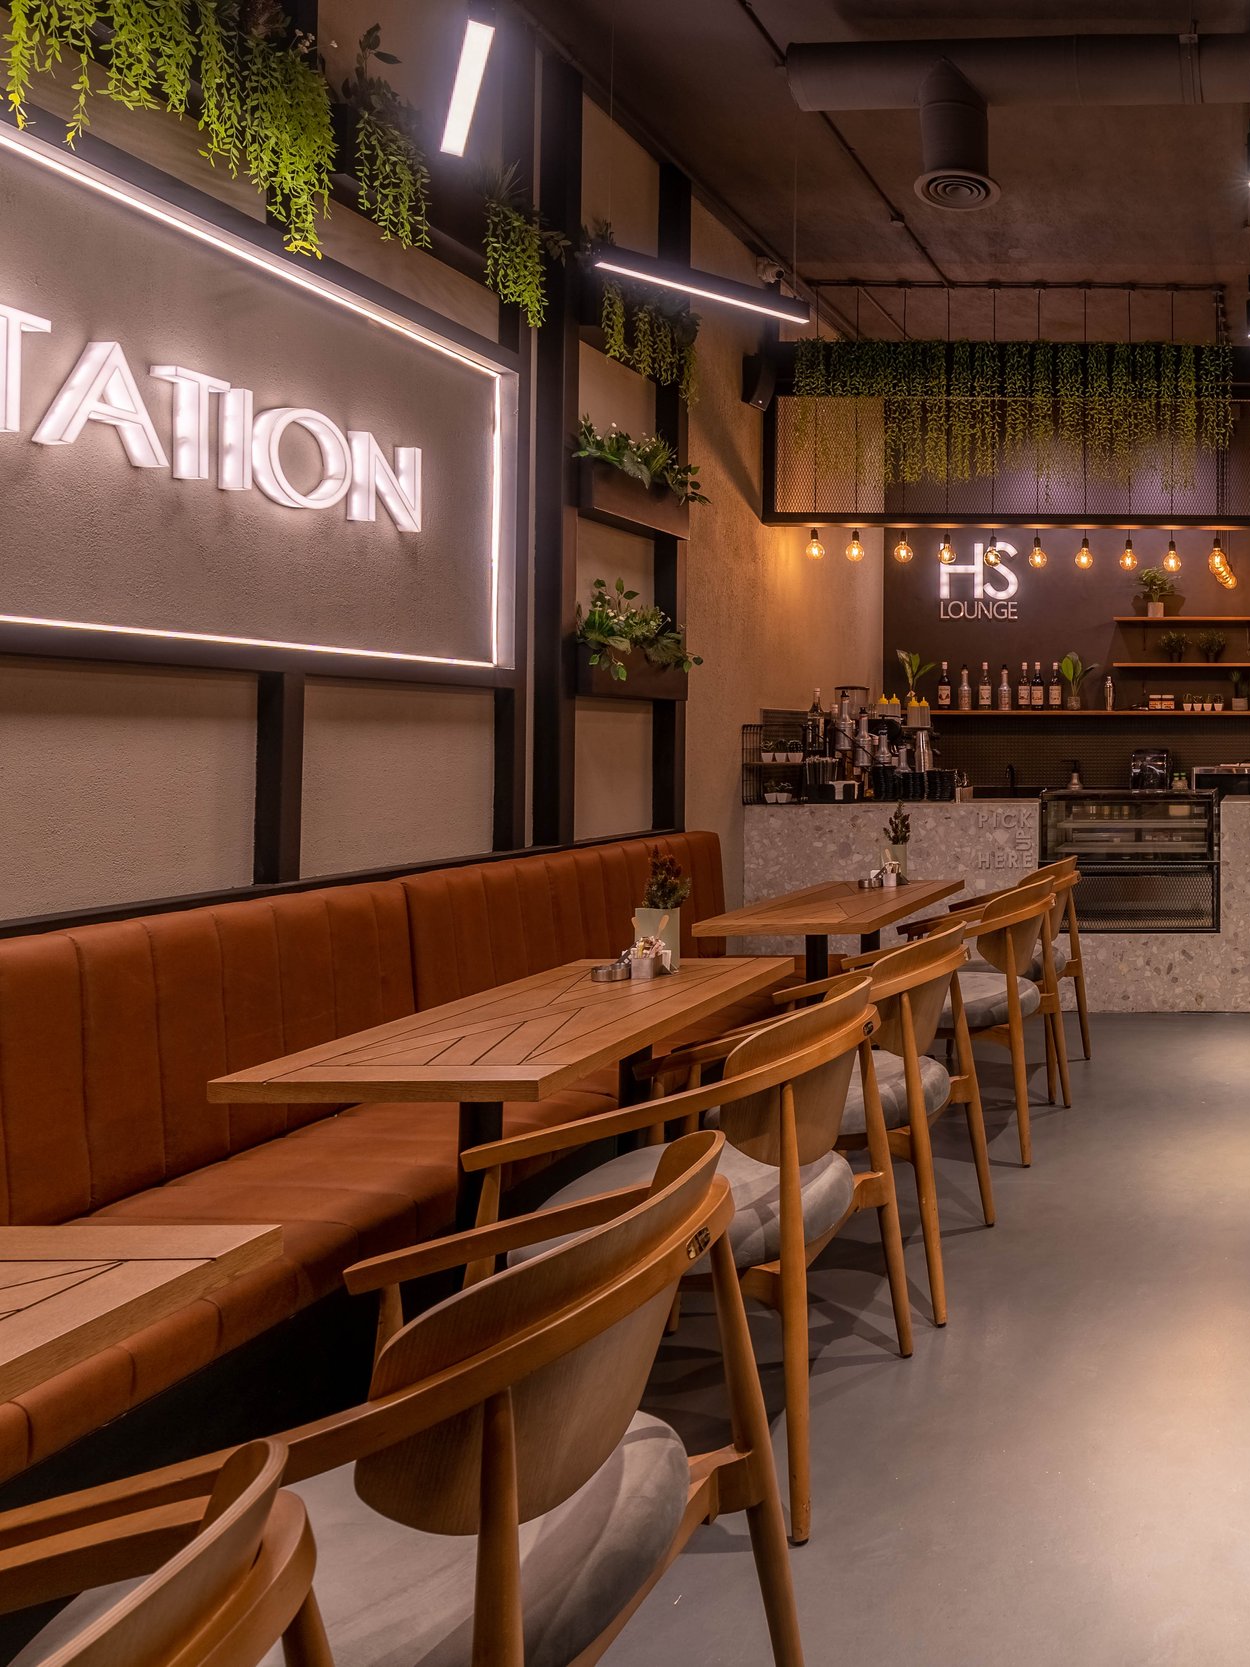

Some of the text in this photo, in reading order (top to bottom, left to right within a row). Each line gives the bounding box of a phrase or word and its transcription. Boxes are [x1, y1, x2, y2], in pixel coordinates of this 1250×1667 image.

[0, 303, 422, 532] TATION
[940, 541, 1019, 600] HS
[940, 600, 1018, 620] LOUNGE
[977, 810, 1033, 829] PICK
[1015, 829, 1033, 852] UP
[977, 851, 1034, 869] HERE
